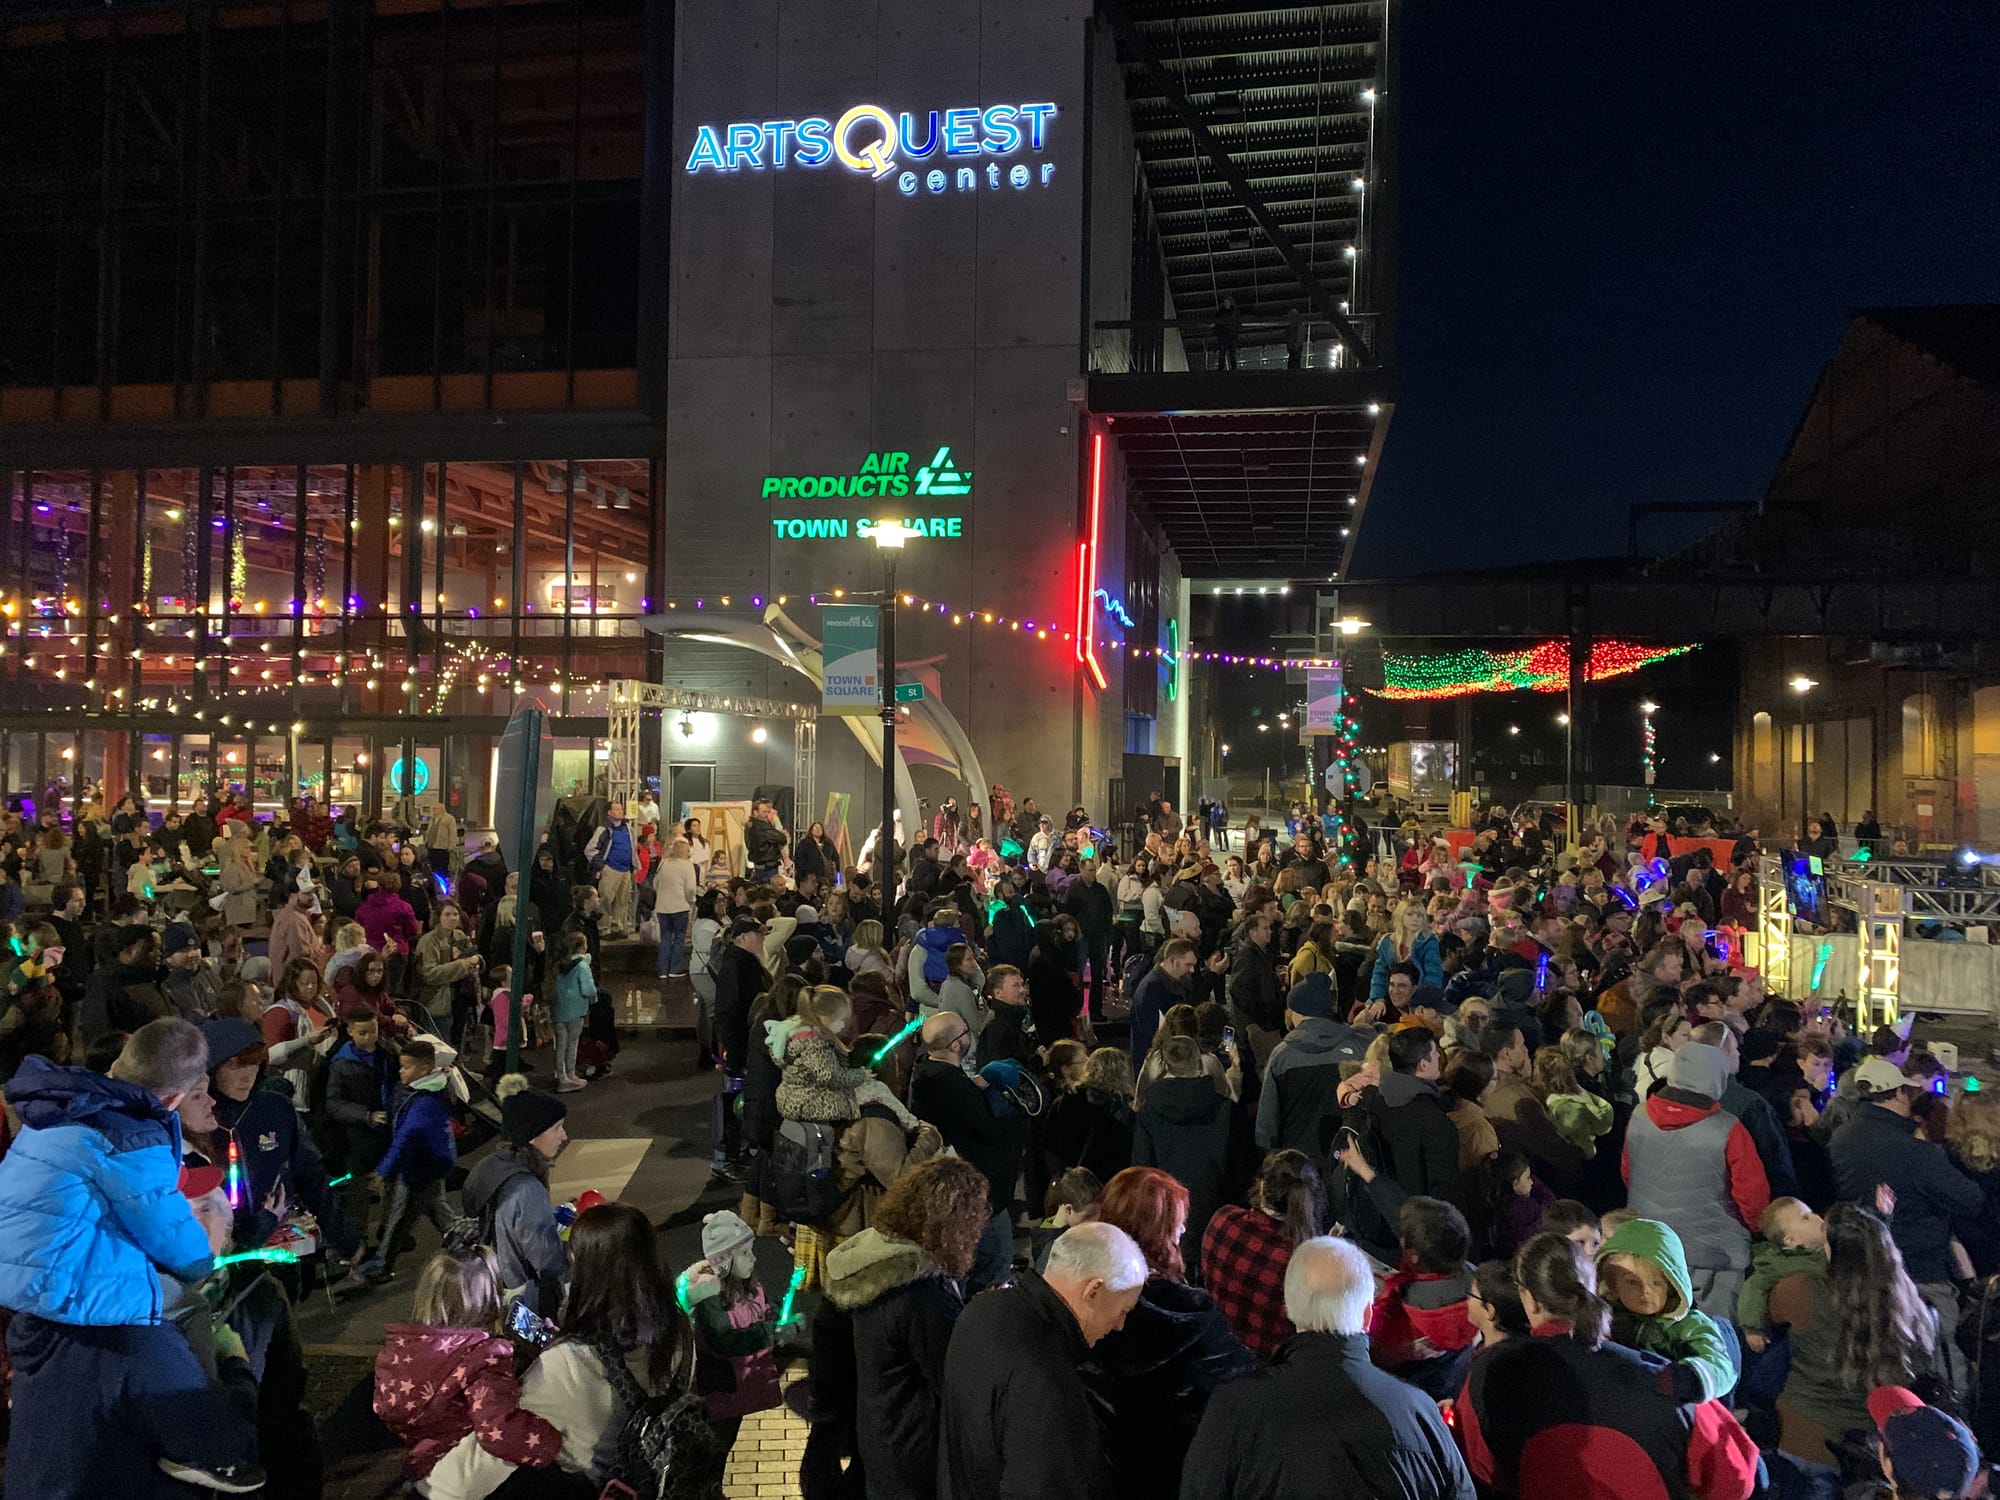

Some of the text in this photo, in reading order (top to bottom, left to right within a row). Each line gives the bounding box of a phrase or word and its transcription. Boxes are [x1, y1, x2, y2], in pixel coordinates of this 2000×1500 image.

[686, 103, 1055, 178] ARTSQUEST
[899, 161, 1053, 193] center
[860, 452, 910, 474] AIR
[761, 475, 910, 498] PRODUCTS
[773, 518, 961, 538] TOWN SARE
[826, 676, 862, 685] TOWN
[826, 687, 875, 696] SQUARE
